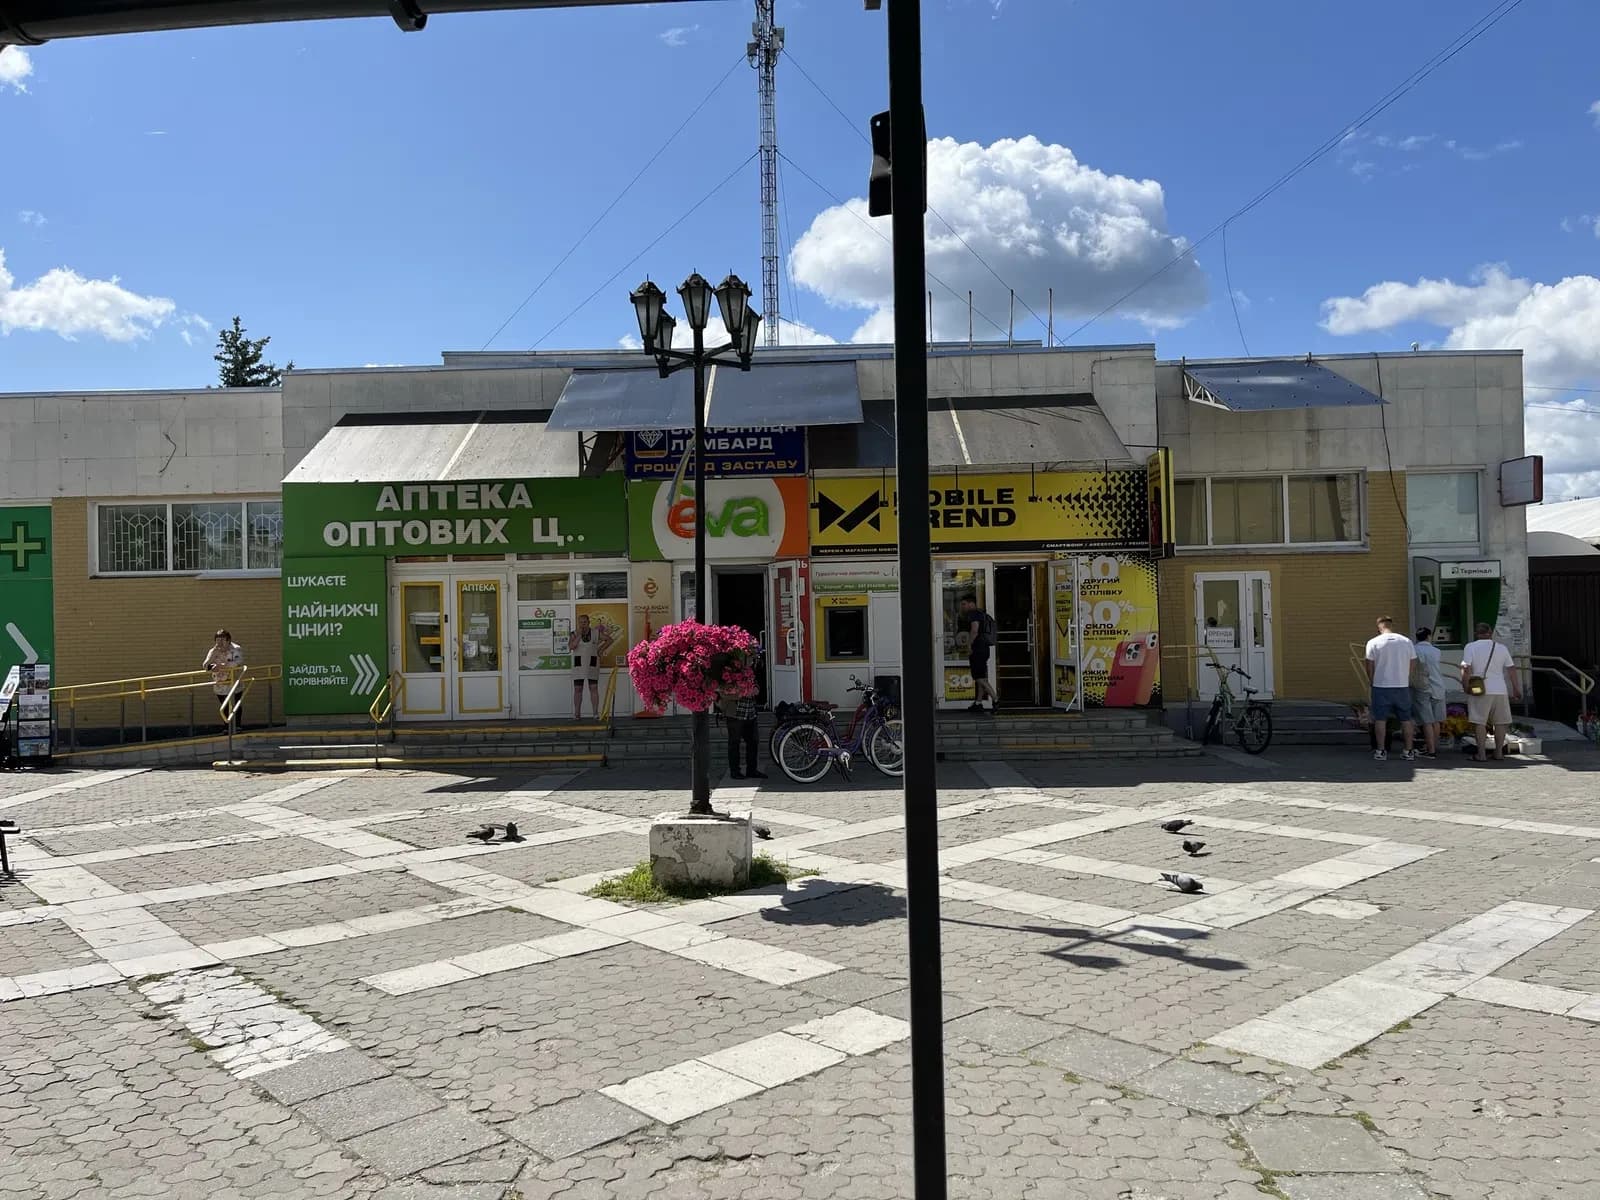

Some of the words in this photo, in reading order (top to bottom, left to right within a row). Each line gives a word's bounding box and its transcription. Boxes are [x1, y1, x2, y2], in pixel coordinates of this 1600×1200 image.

[633, 463, 681, 473] ГРОШ
[689, 462, 716, 473] ПД
[720, 460, 798, 472] ЗАСТАВУ
[376, 483, 533, 511] АПТЕКА
[893, 488, 1015, 507] OBILE
[322, 518, 510, 547] ОПТОВИХ
[1460, 567, 1493, 575] Термінал
[287, 575, 347, 587] ШУКАЄТЕ
[1082, 576, 1120, 585] ДРУГИЙ
[462, 583, 496, 592] АПТЕКА
[287, 601, 378, 618] НАЙНИЖЧІ
[288, 622, 343, 639] ЦІНИ!?
[289, 664, 328, 675] ЗАЙДІТЬ
[330, 665, 342, 673] ТА
[289, 675, 348, 686] ПОРІВНЯЙТЕ!
